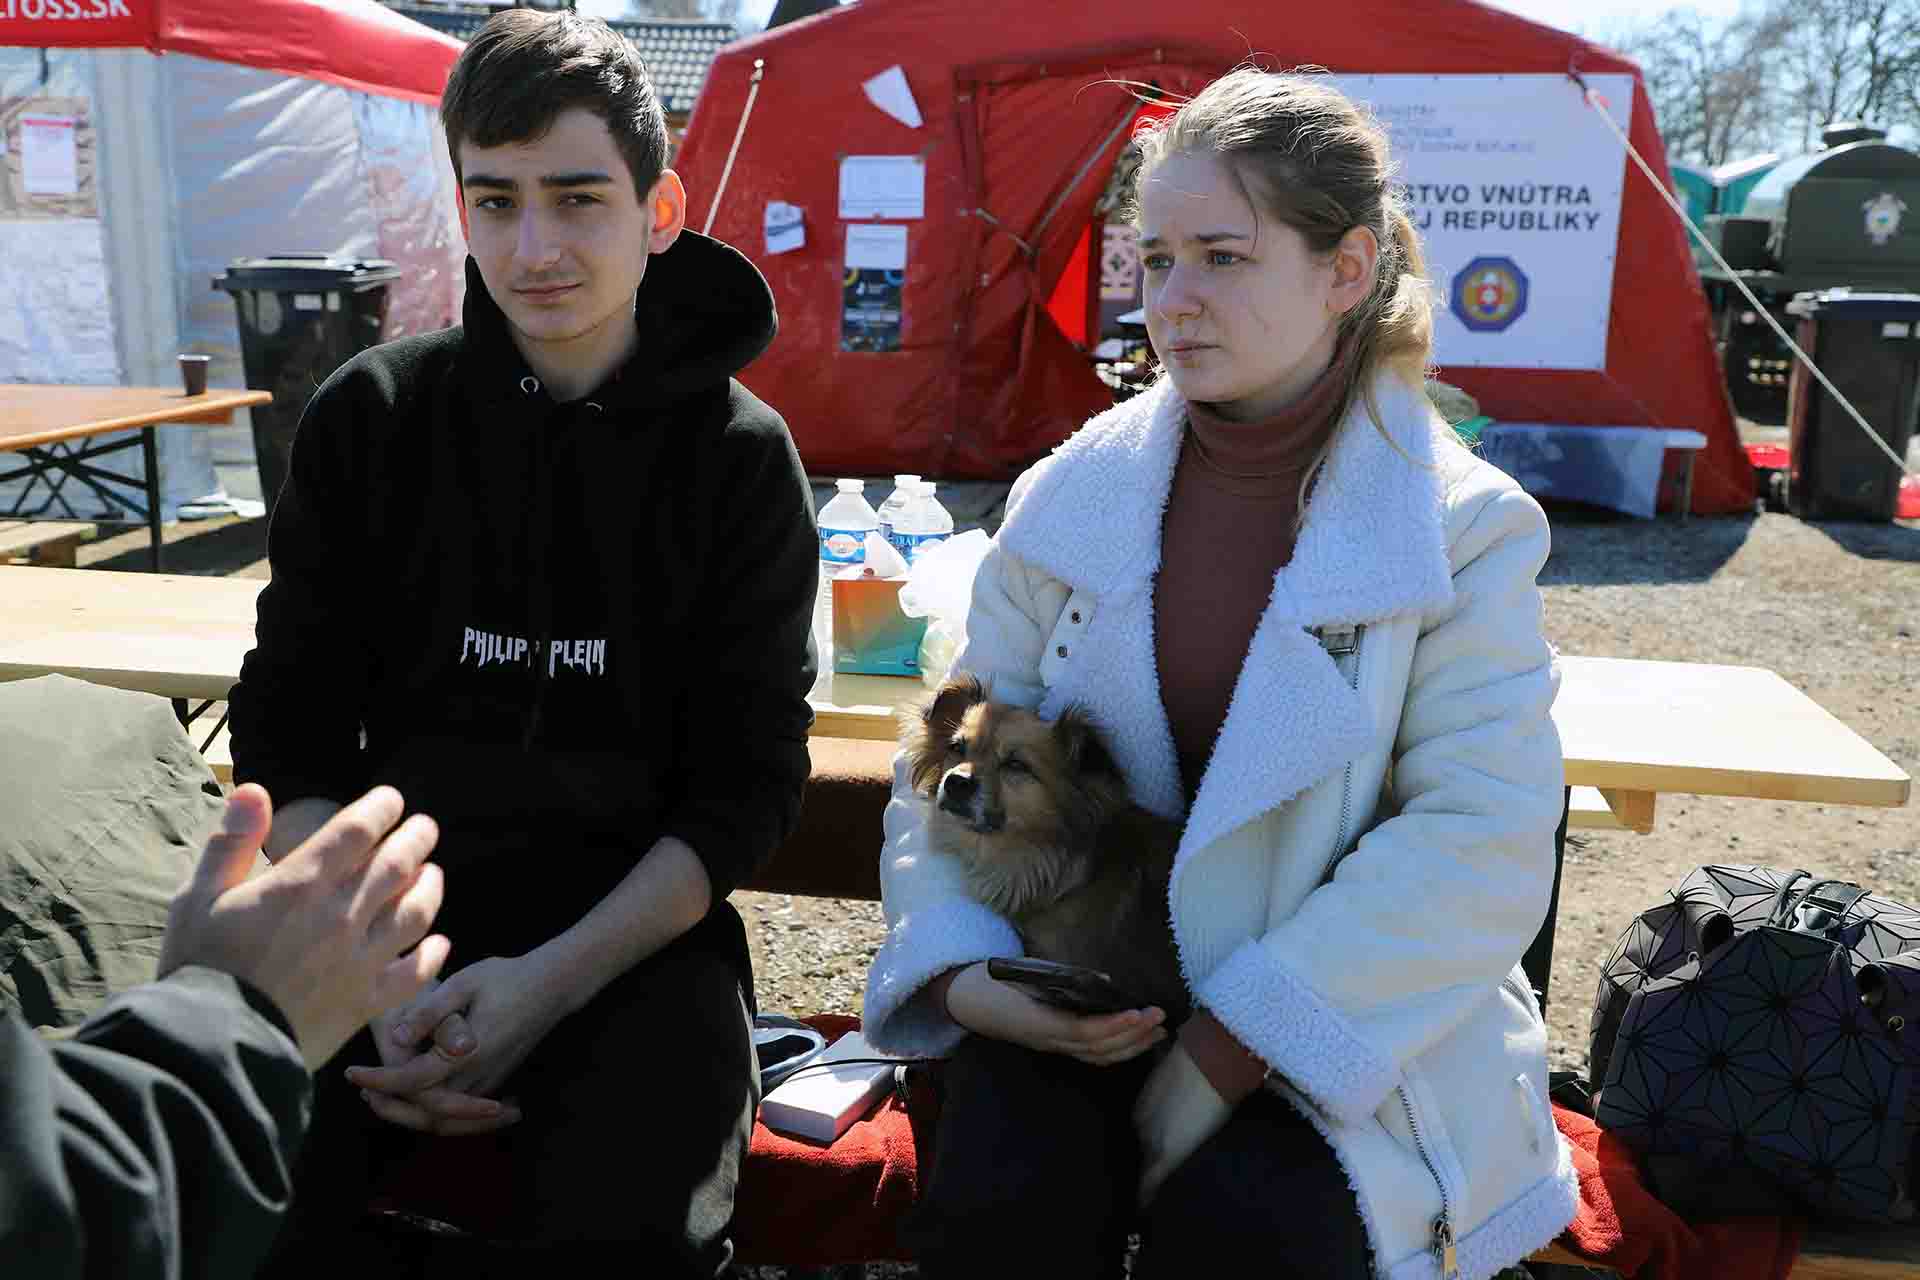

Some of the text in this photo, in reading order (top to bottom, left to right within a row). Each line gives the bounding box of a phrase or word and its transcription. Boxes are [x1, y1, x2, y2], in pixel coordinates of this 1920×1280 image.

[1481, 180, 1591, 205] VNÚTRA
[1443, 209, 1601, 231] REPUBLIKY
[549, 639, 606, 679] PLEIN
